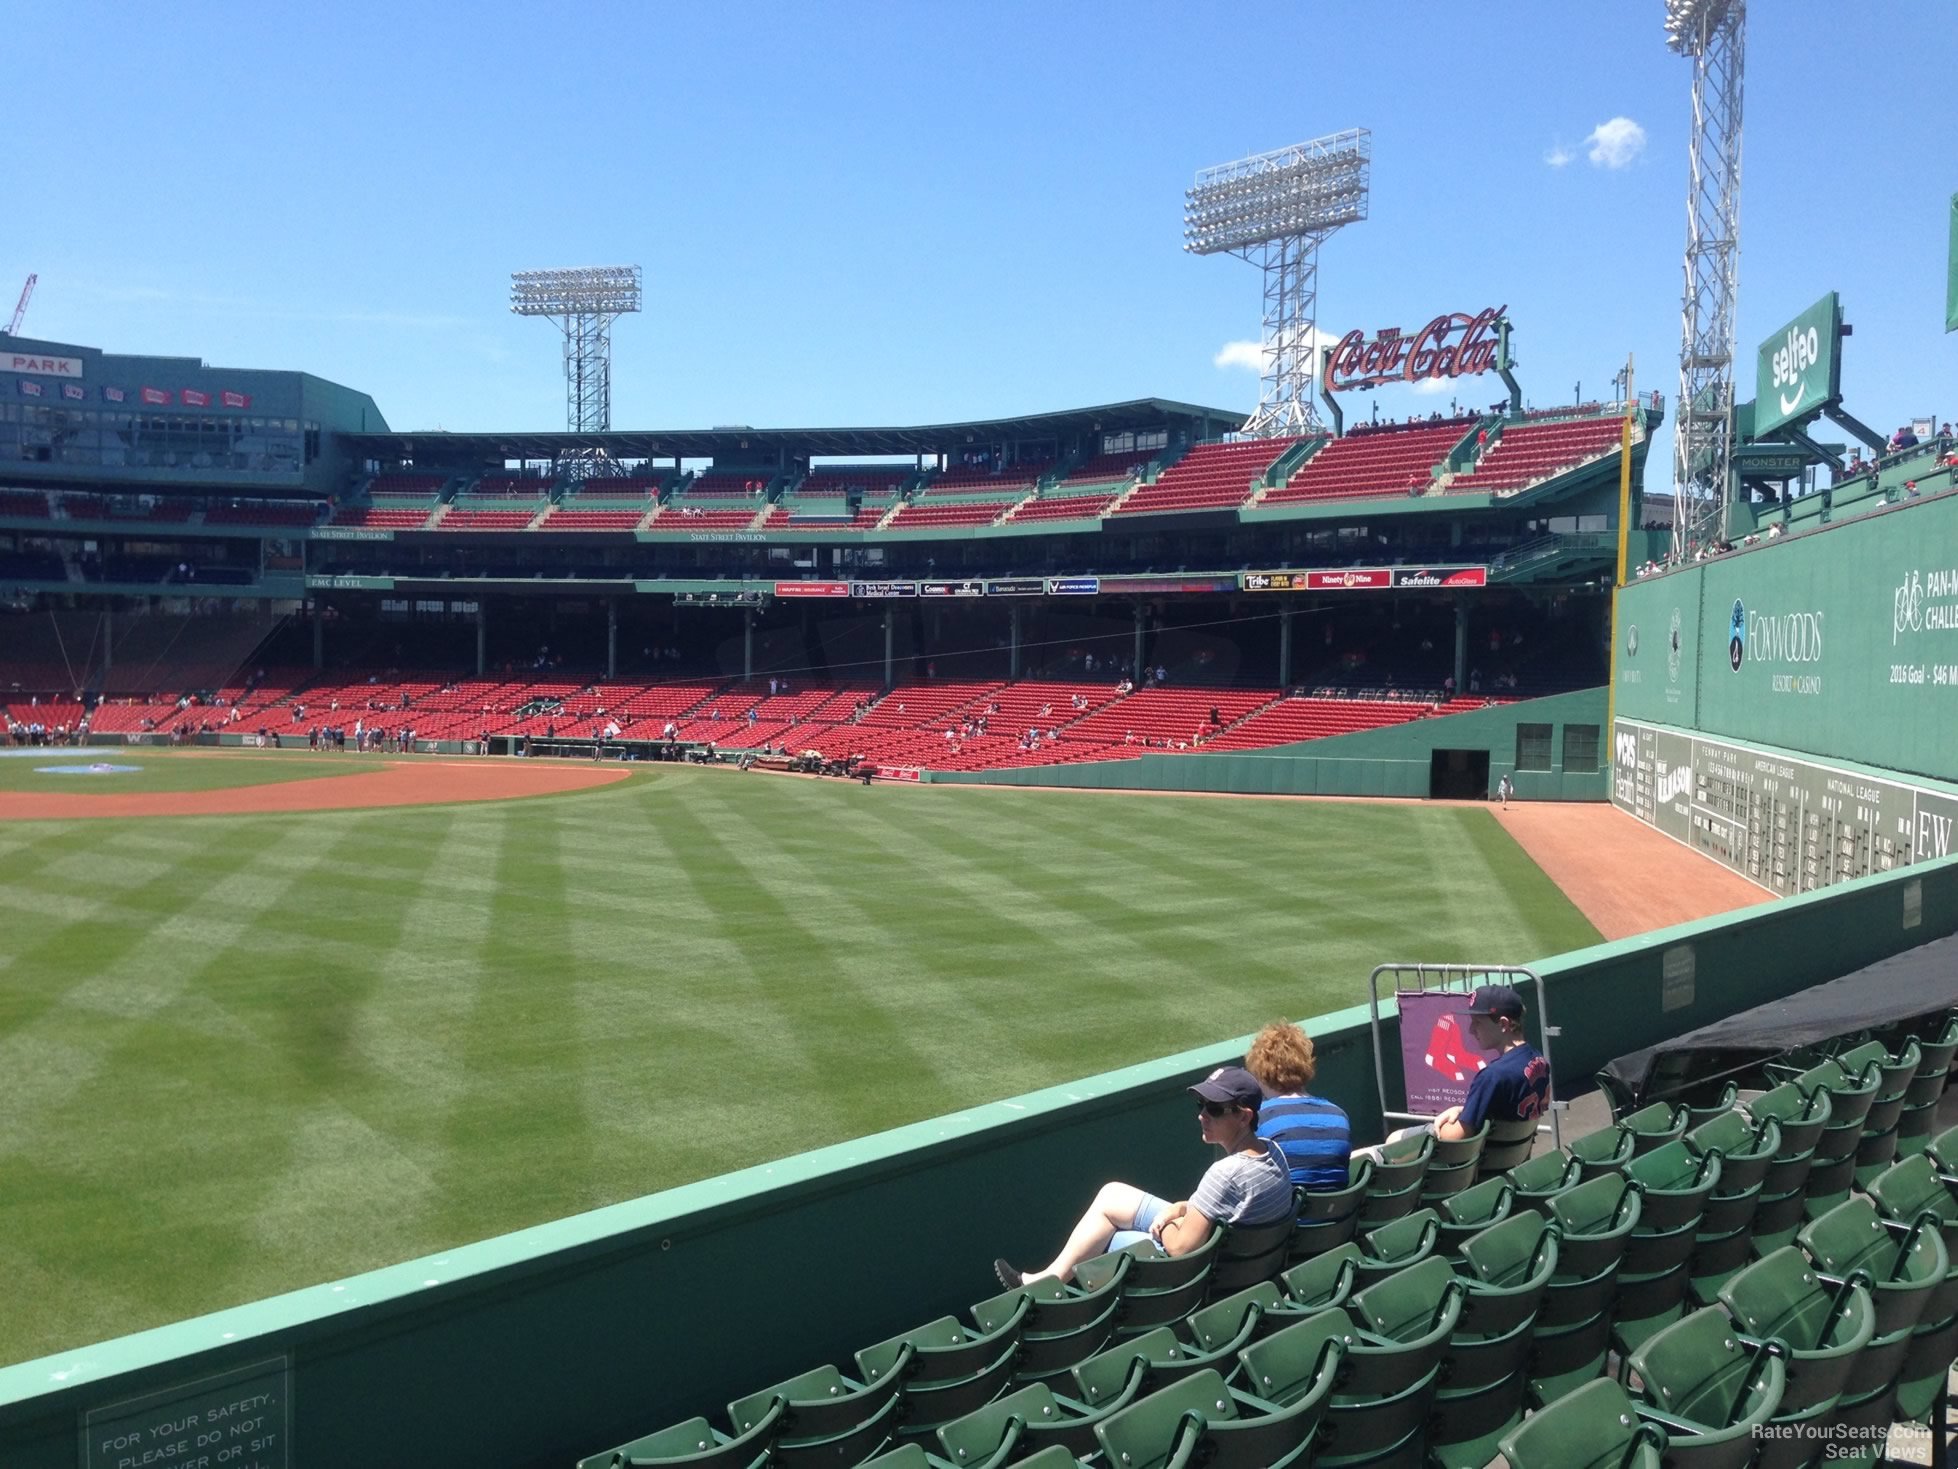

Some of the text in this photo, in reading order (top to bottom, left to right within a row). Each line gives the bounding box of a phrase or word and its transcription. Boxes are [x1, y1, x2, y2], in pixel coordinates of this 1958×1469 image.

[1324, 304, 1508, 392] Coca-Cola
[13, 356, 70, 373] PARK
[1742, 457, 1800, 467] MONSTER
[711, 533, 733, 541] STREET
[735, 533, 767, 541] PAVILION
[334, 579, 362, 587] LEVEL
[1246, 575, 1269, 589] Tribe
[1322, 575, 1344, 584] Ninety
[1355, 575, 1371, 583] Nine
[1400, 575, 1441, 586] Safelite
[1748, 610, 1822, 662] FOXWOODS
[1798, 675, 1821, 694] CASINO
[1890, 664, 1907, 683] 2016
[1908, 664, 1924, 684] Goal
[1933, 663, 1948, 687] $46
[1755, 760, 1795, 780] AMERICAN LEAGUE
[1827, 779, 1881, 803] NATIONAL LEAGUE
[102, 1393, 276, 1453] FOR YOUR SAFETY,
[118, 1416, 264, 1469] PLEASE DO NOT
[217, 1445, 242, 1463] OR
[250, 1434, 276, 1452] SIT
